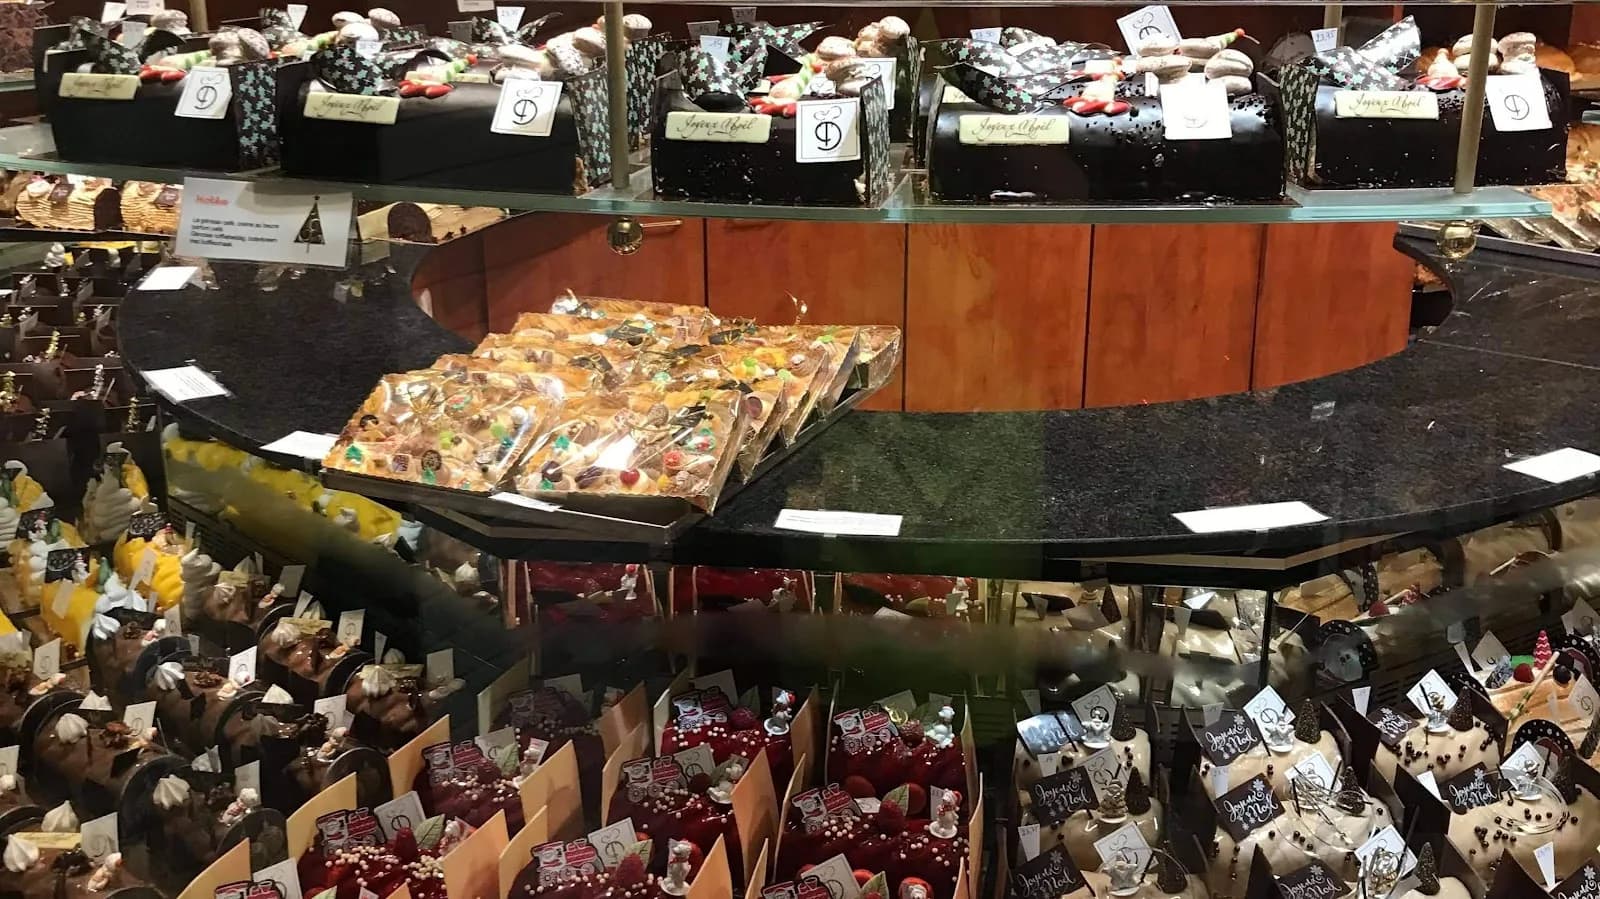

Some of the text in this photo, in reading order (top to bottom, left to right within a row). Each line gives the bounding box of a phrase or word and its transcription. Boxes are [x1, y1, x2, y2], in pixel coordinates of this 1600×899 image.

[1205, 724, 1244, 752] Joyeux
[1034, 781, 1080, 807] Joyeux
[1224, 790, 1264, 823] Joyeux
